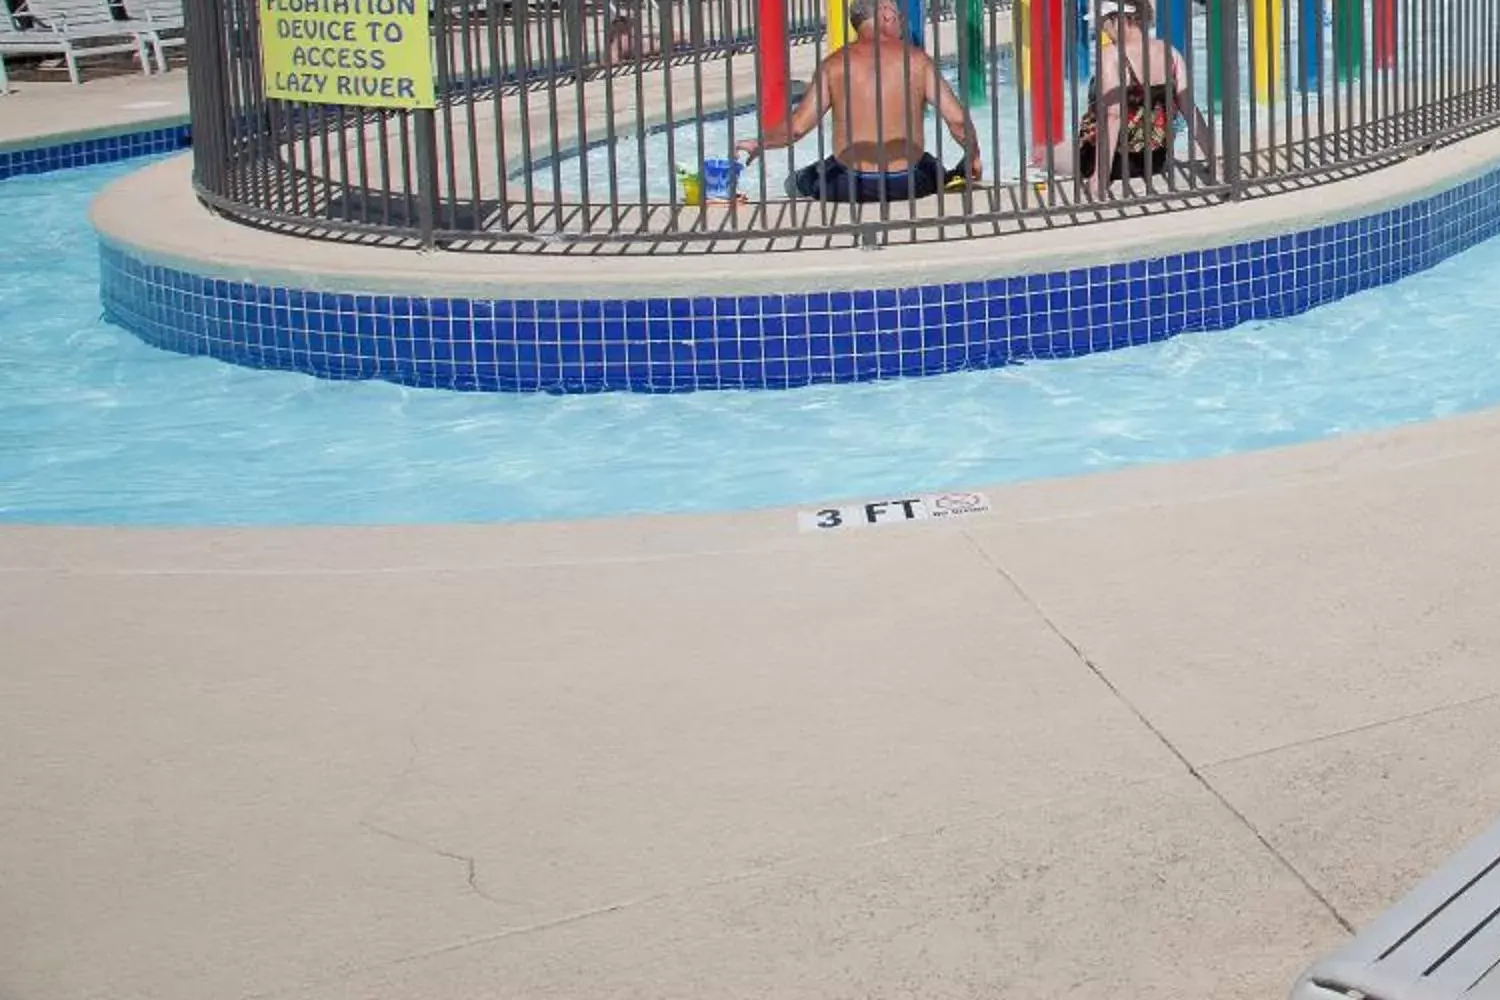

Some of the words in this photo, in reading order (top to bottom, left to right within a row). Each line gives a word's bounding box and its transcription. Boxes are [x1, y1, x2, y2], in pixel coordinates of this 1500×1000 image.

[277, 19, 357, 41] DEVICE
[366, 21, 403, 43] TO
[293, 47, 386, 70] ACCESS
[275, 72, 328, 93] LAZY
[337, 75, 416, 98] RIVER
[816, 508, 843, 529] 3
[864, 498, 921, 524] FT
